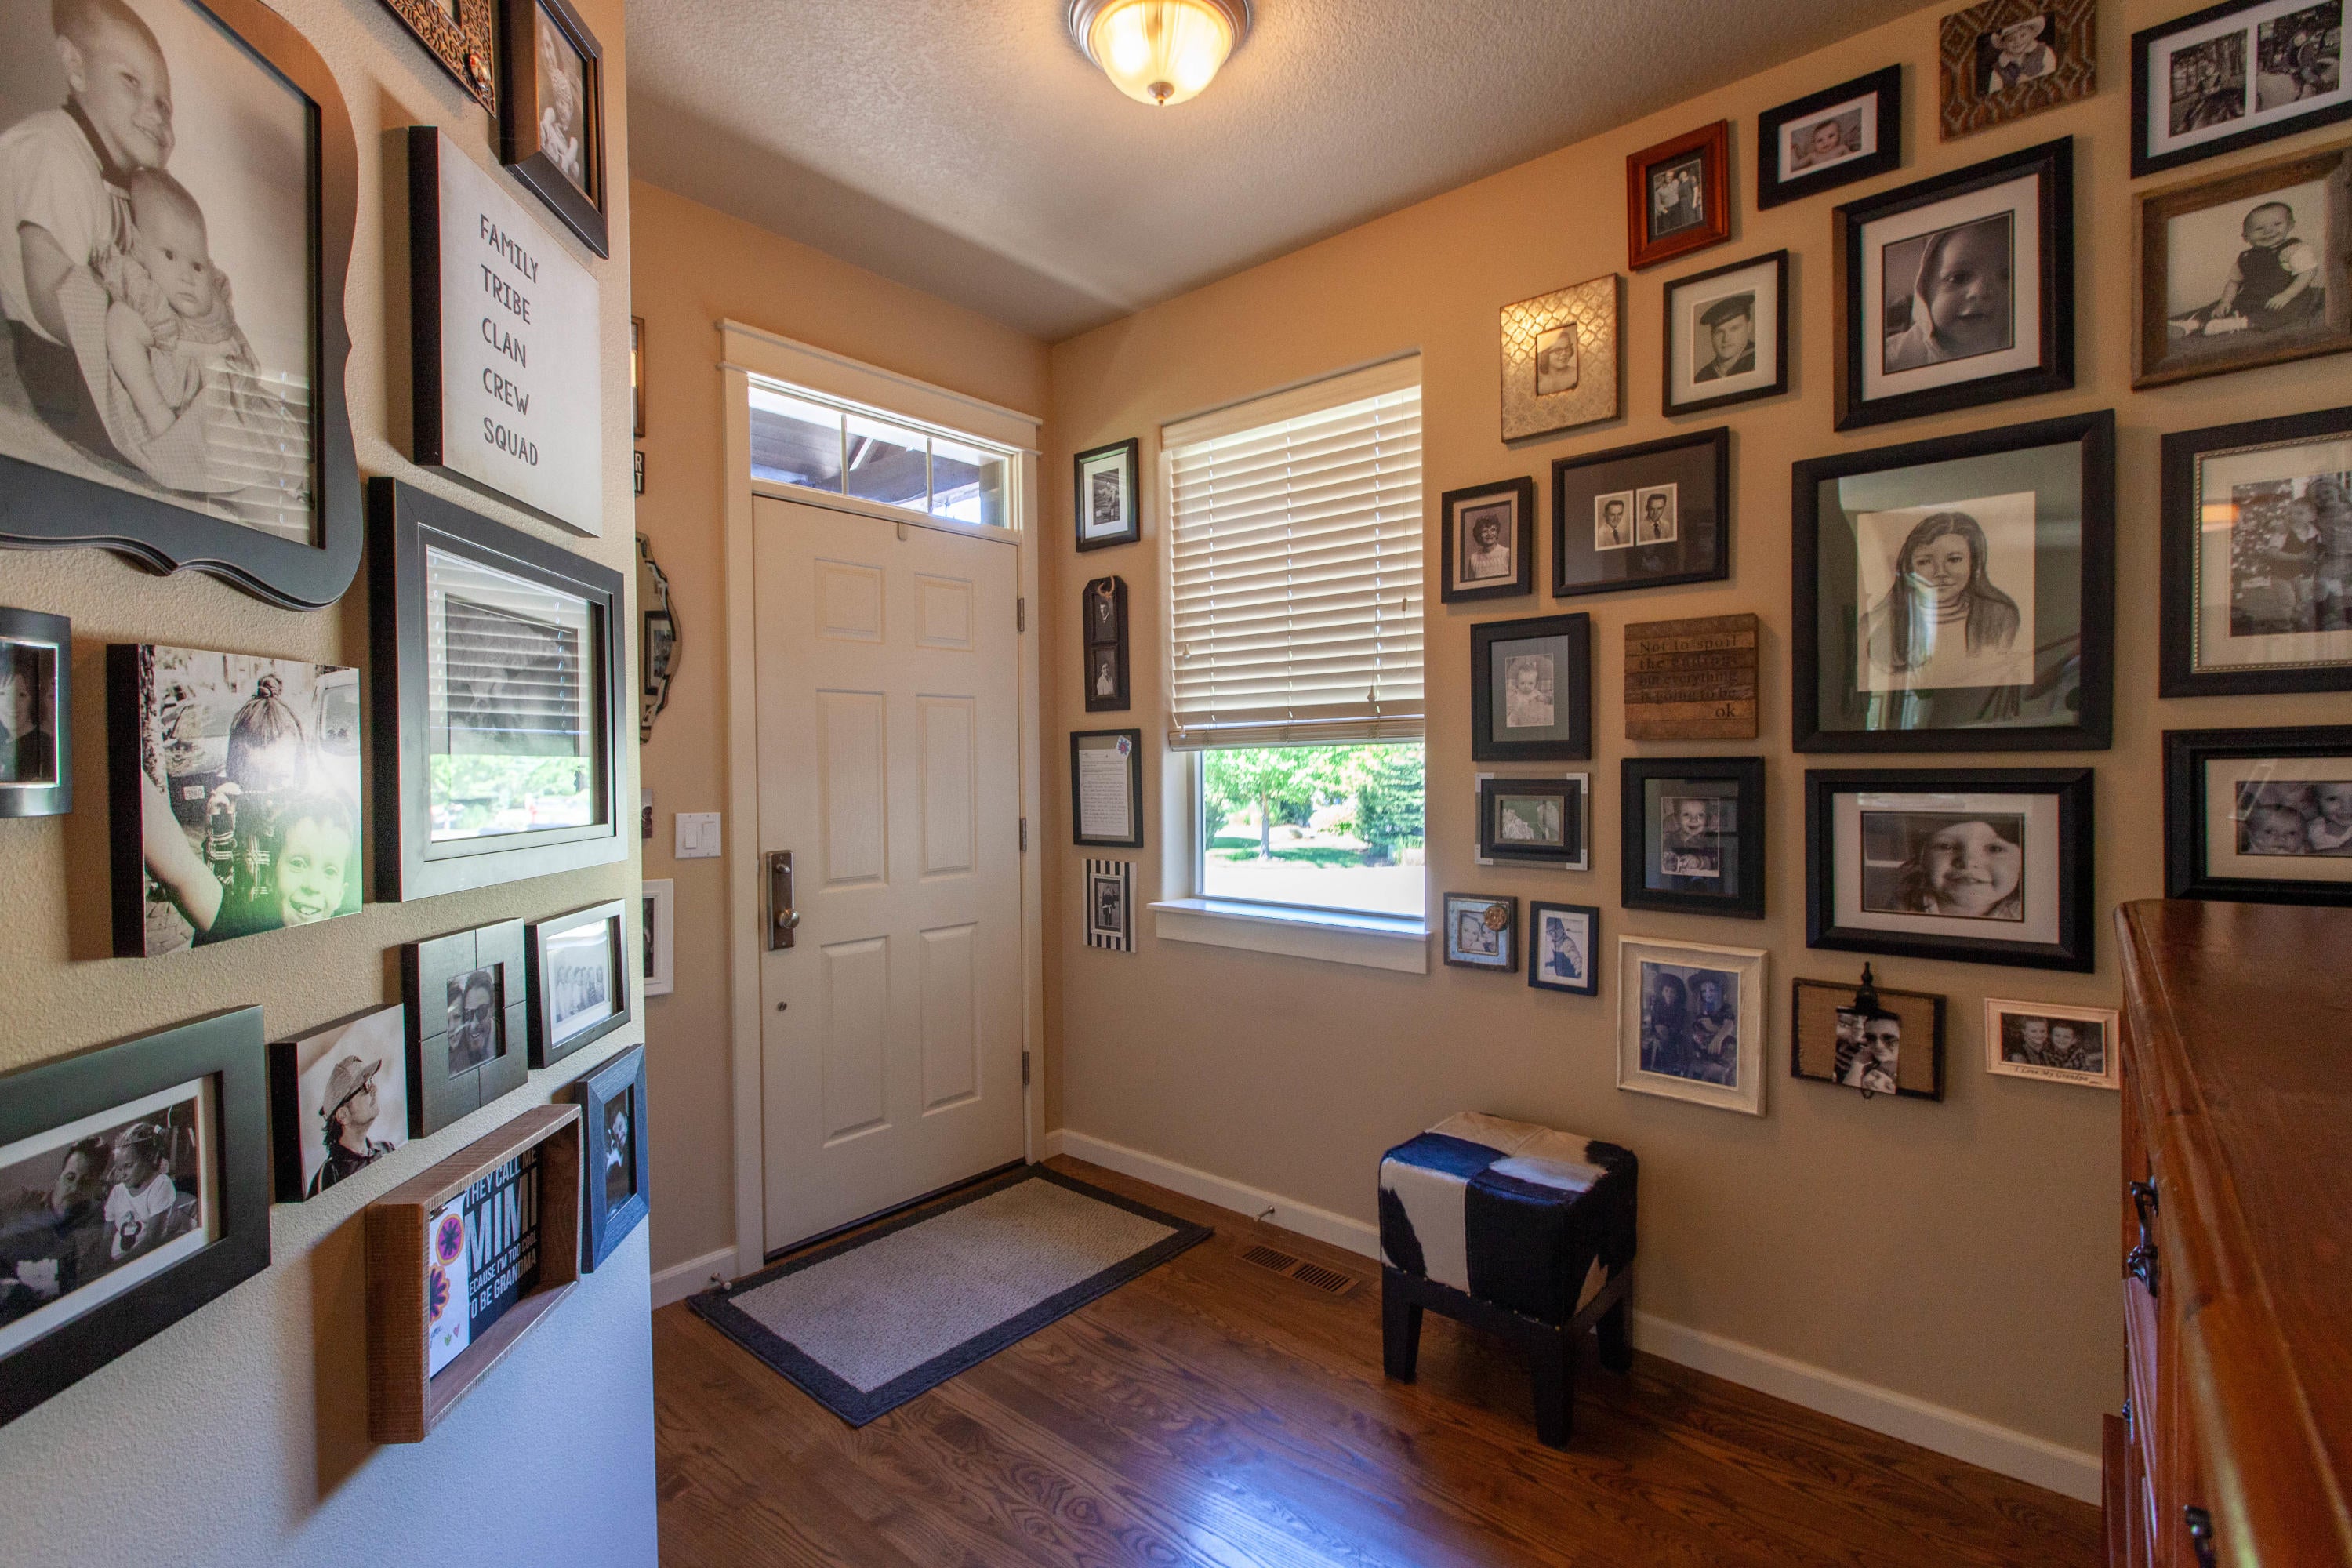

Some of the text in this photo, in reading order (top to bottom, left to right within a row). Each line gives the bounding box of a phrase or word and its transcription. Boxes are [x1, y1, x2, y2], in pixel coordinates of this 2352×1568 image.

[481, 213, 539, 283] FAMILY
[481, 264, 531, 325] TRIBE
[482, 318, 527, 368] CLAN
[483, 368, 529, 416] CREW
[484, 417, 539, 466] SQUAD
[1697, 634, 1737, 652] spoil
[1715, 702, 1736, 718] ok
[464, 1171, 494, 1208] THEY
[495, 1156, 521, 1188] CALL
[464, 1167, 537, 1277] MIMI
[469, 1263, 496, 1297] ECAUSE
[497, 1253, 508, 1274] I'M
[508, 1243, 521, 1264] TOO
[480, 1284, 492, 1312] BE
[494, 1247, 537, 1299] GRANDMA
